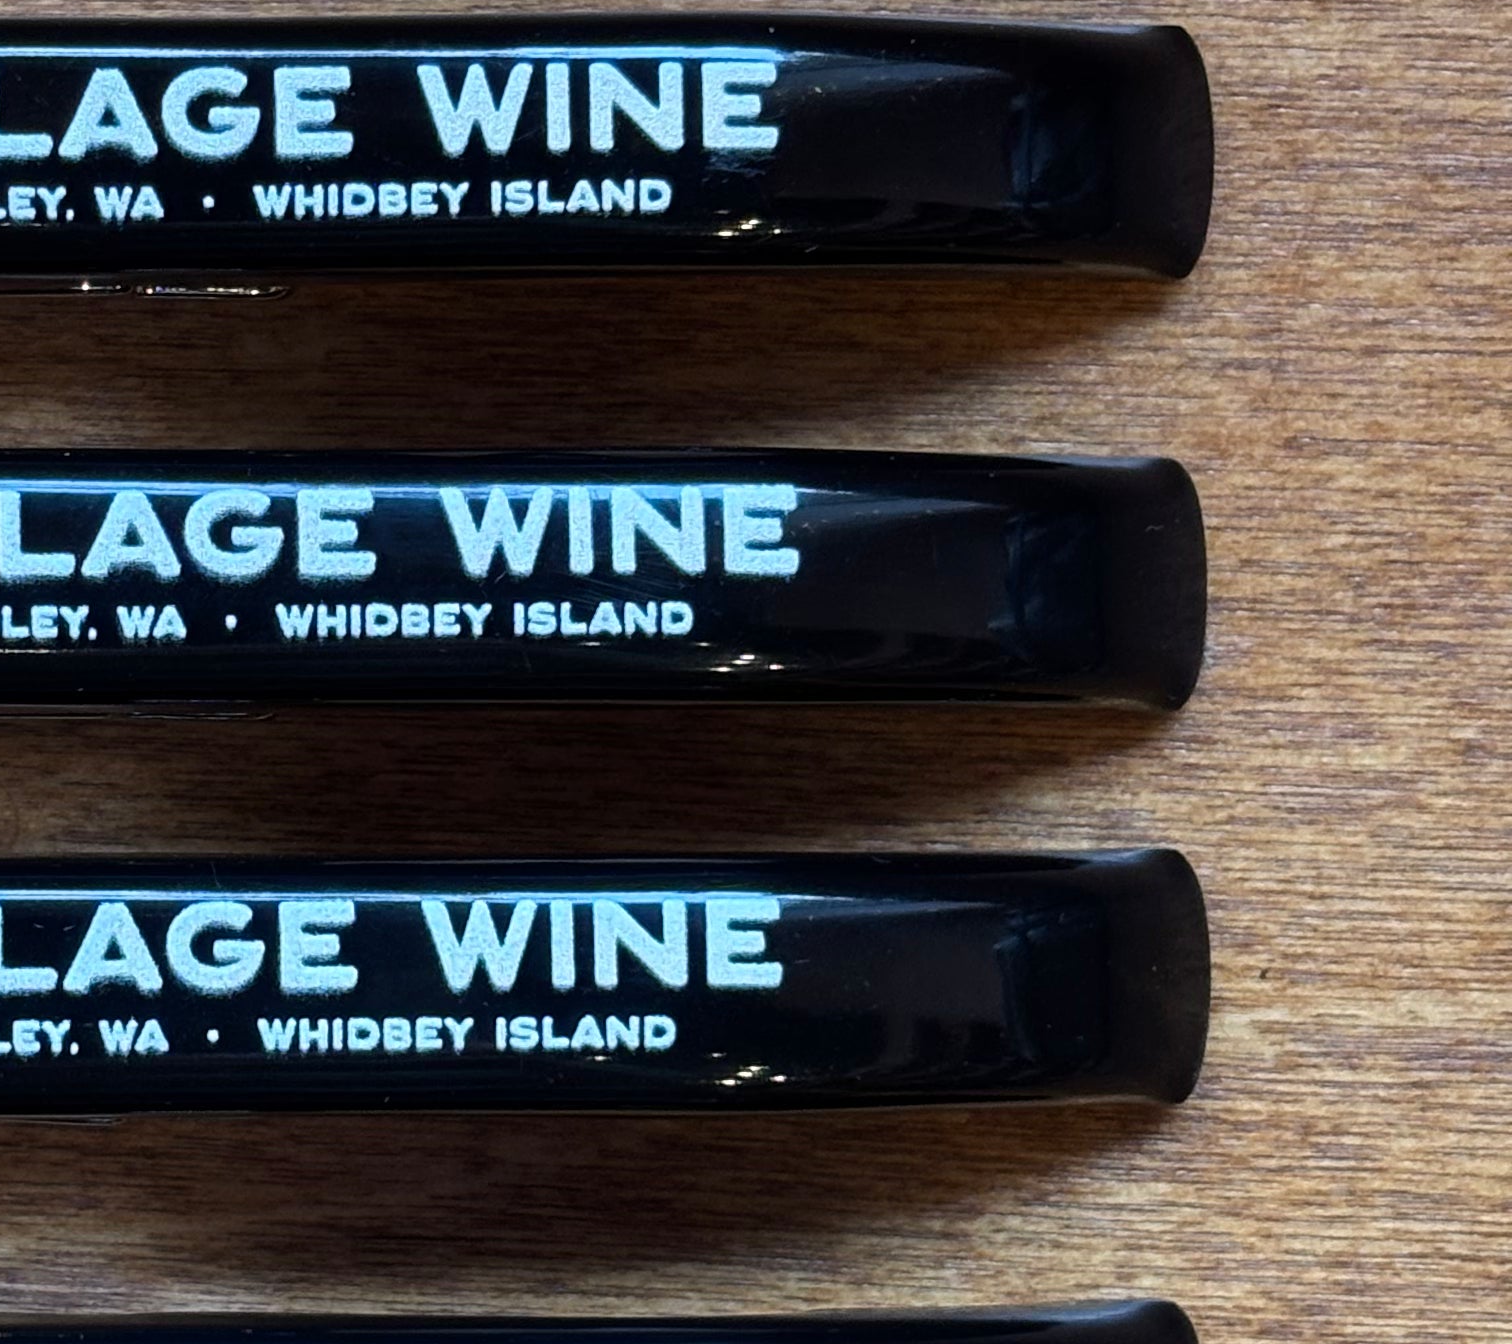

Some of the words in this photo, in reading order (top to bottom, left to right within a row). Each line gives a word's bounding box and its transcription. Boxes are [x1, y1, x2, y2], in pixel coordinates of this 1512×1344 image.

[416, 60, 780, 156] WINE
[94, 186, 164, 220] WA
[253, 182, 469, 219] WHIDBEY
[491, 179, 672, 216] ISLAND
[438, 483, 800, 577] WINE
[117, 605, 187, 639] WA
[275, 603, 492, 638] WHIDBEY
[514, 601, 693, 635] ISLAND
[421, 896, 783, 992] WINE
[99, 1017, 169, 1056] WA
[257, 1016, 474, 1053] WHIDBEY
[496, 1015, 676, 1052] ISLAND
